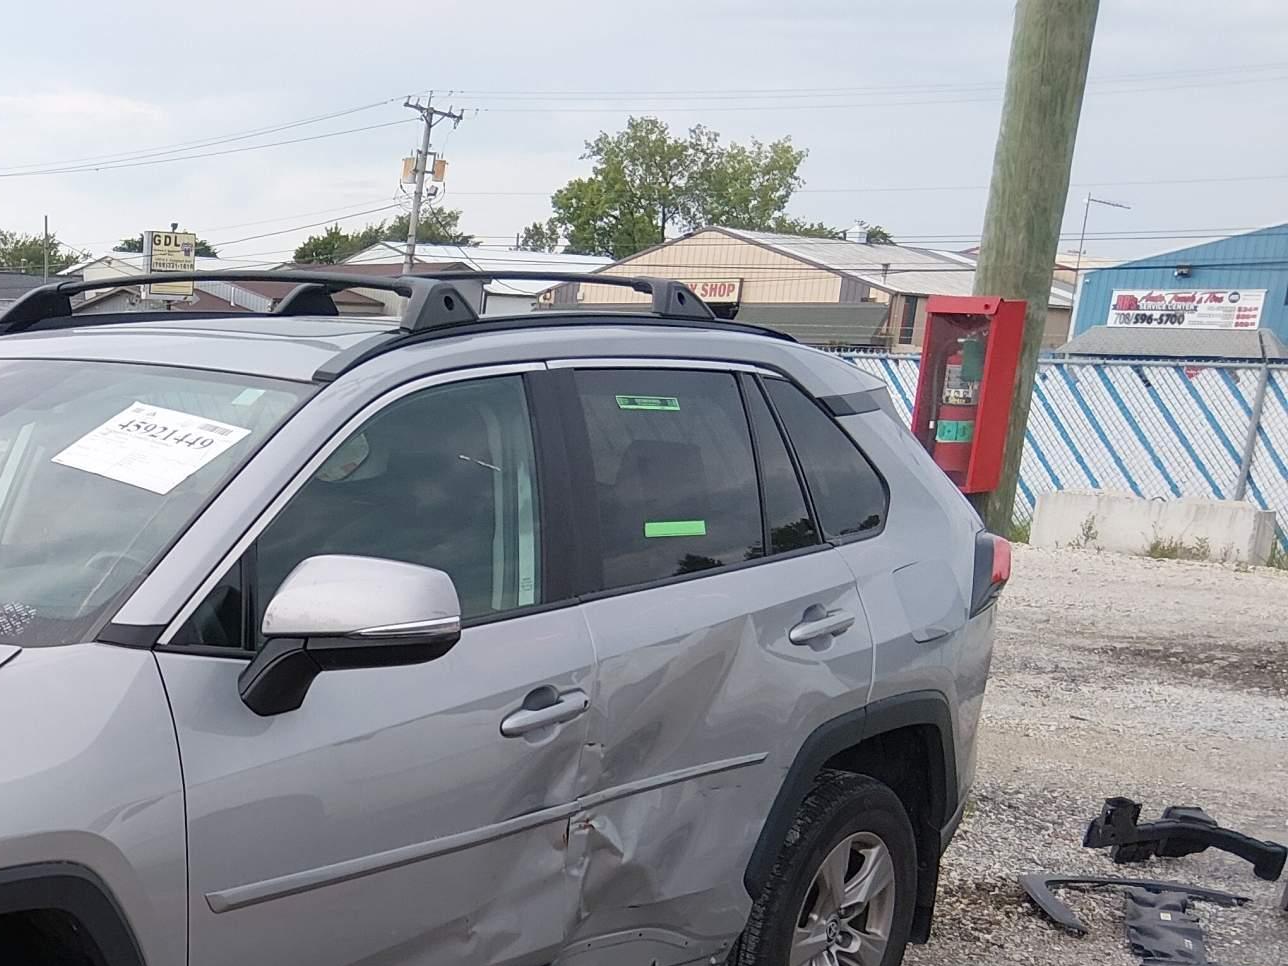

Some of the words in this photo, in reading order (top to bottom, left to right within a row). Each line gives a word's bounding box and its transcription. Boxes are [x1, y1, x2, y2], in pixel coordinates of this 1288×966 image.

[153, 234, 180, 247] GDL
[700, 283, 736, 298] SHOP
[1139, 303, 1166, 311] SERVICE
[1168, 303, 1195, 311] CENTER
[118, 419, 214, 450] 45921449
